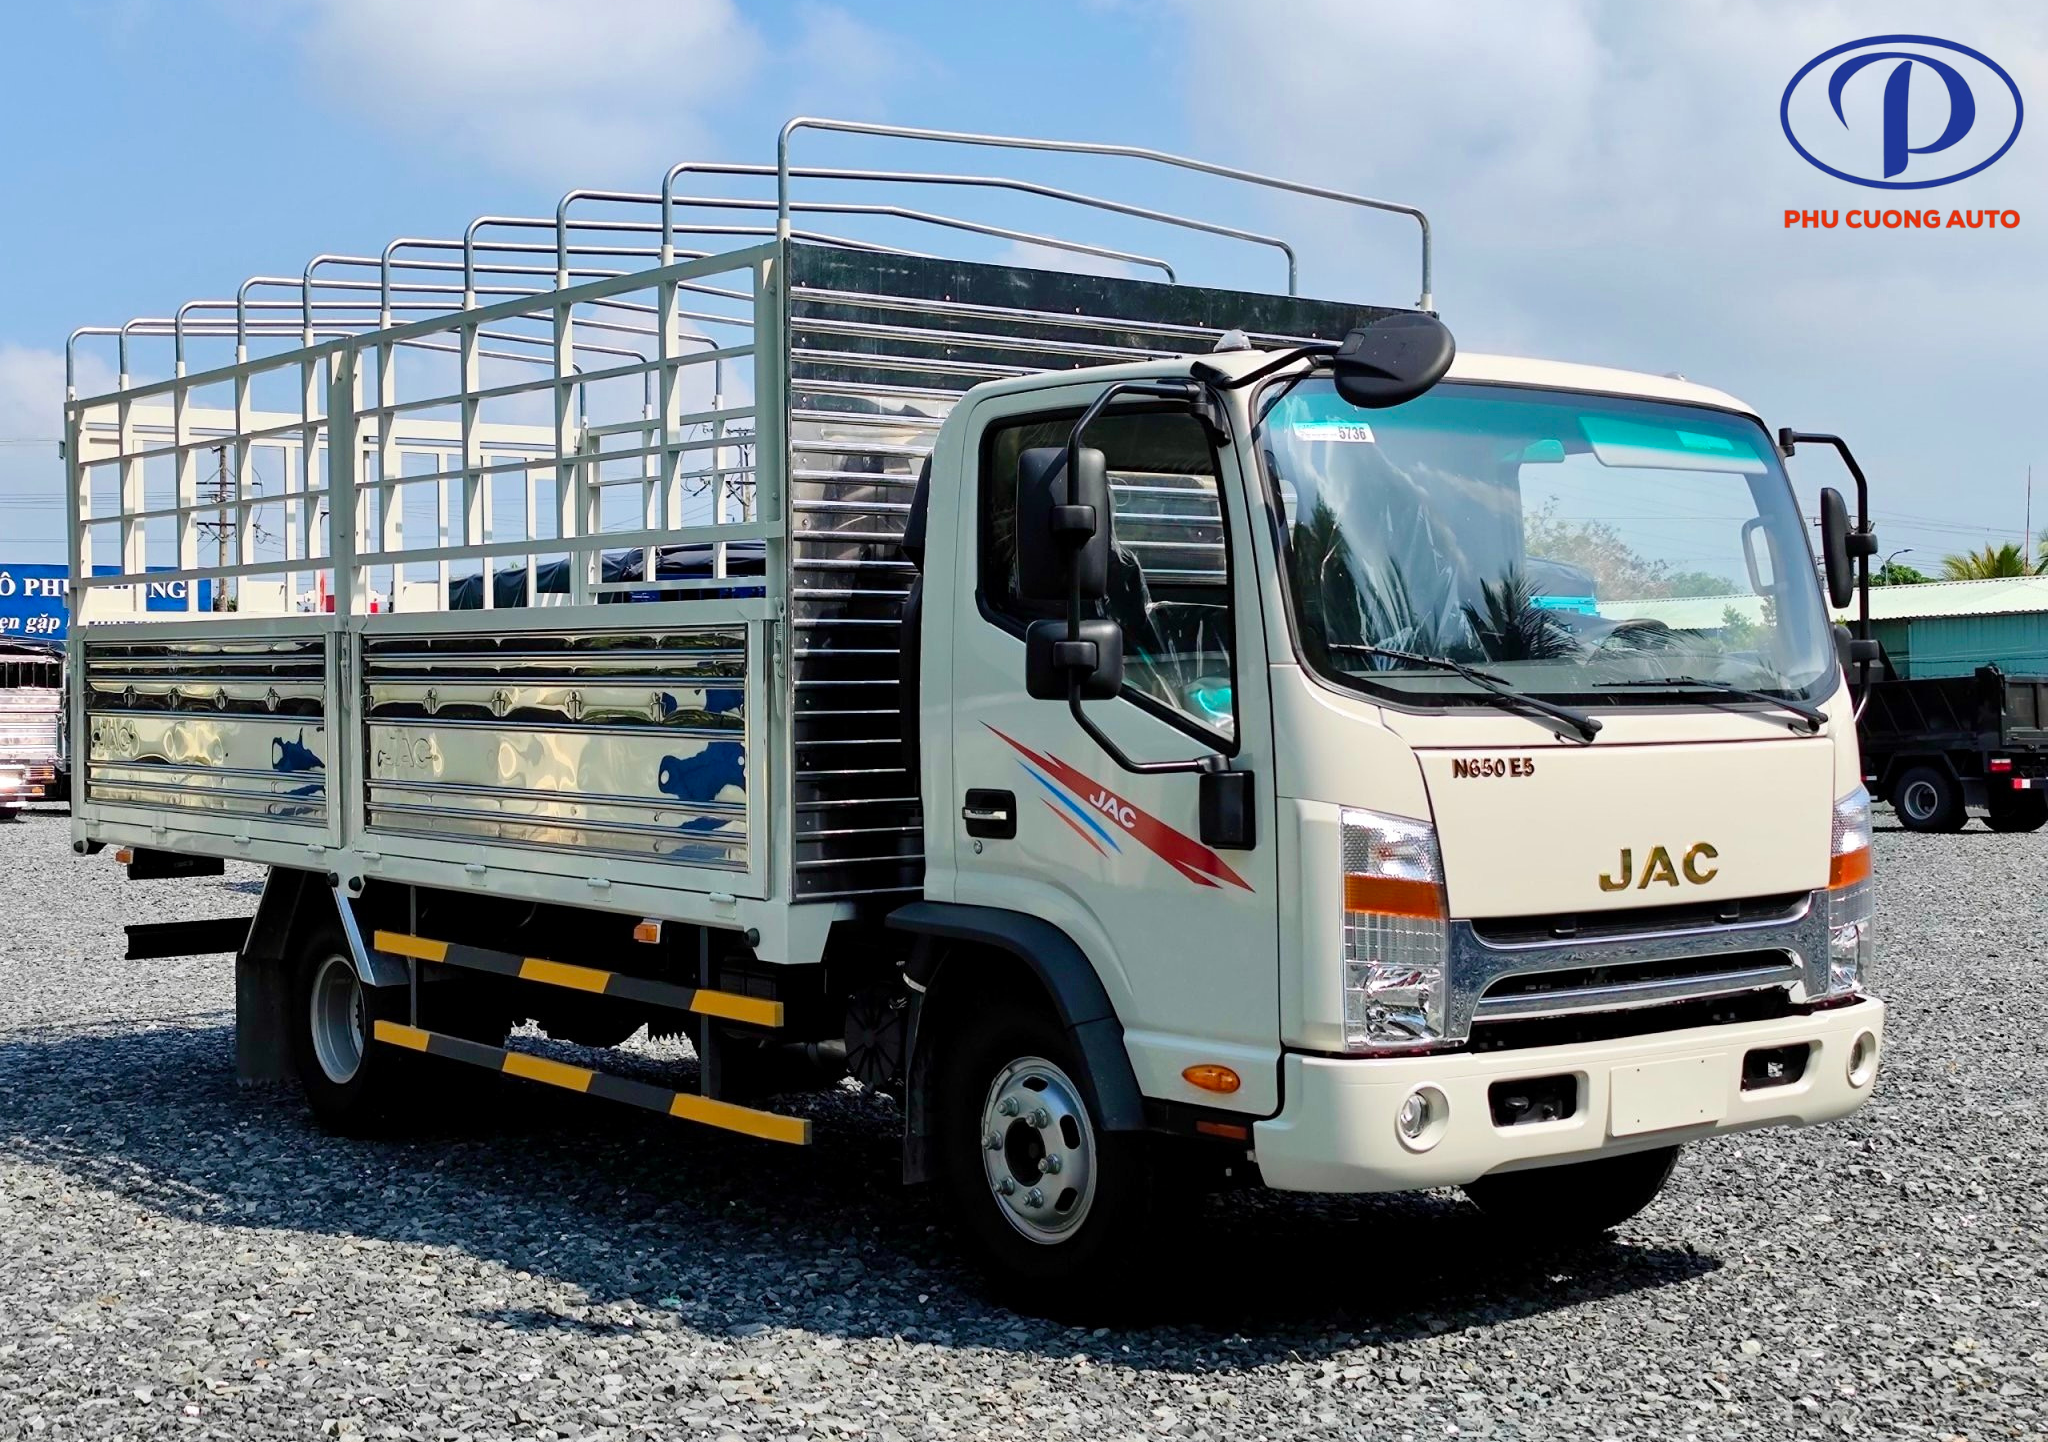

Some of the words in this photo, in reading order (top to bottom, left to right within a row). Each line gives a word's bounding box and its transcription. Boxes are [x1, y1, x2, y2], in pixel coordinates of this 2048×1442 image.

[1338, 426, 1367, 440] 5736
[25, 613, 61, 634] gặp
[1451, 757, 1506, 778] N650
[1508, 757, 1535, 778] E5
[1089, 790, 1137, 829] JAC
[1599, 842, 1719, 892] JAC
